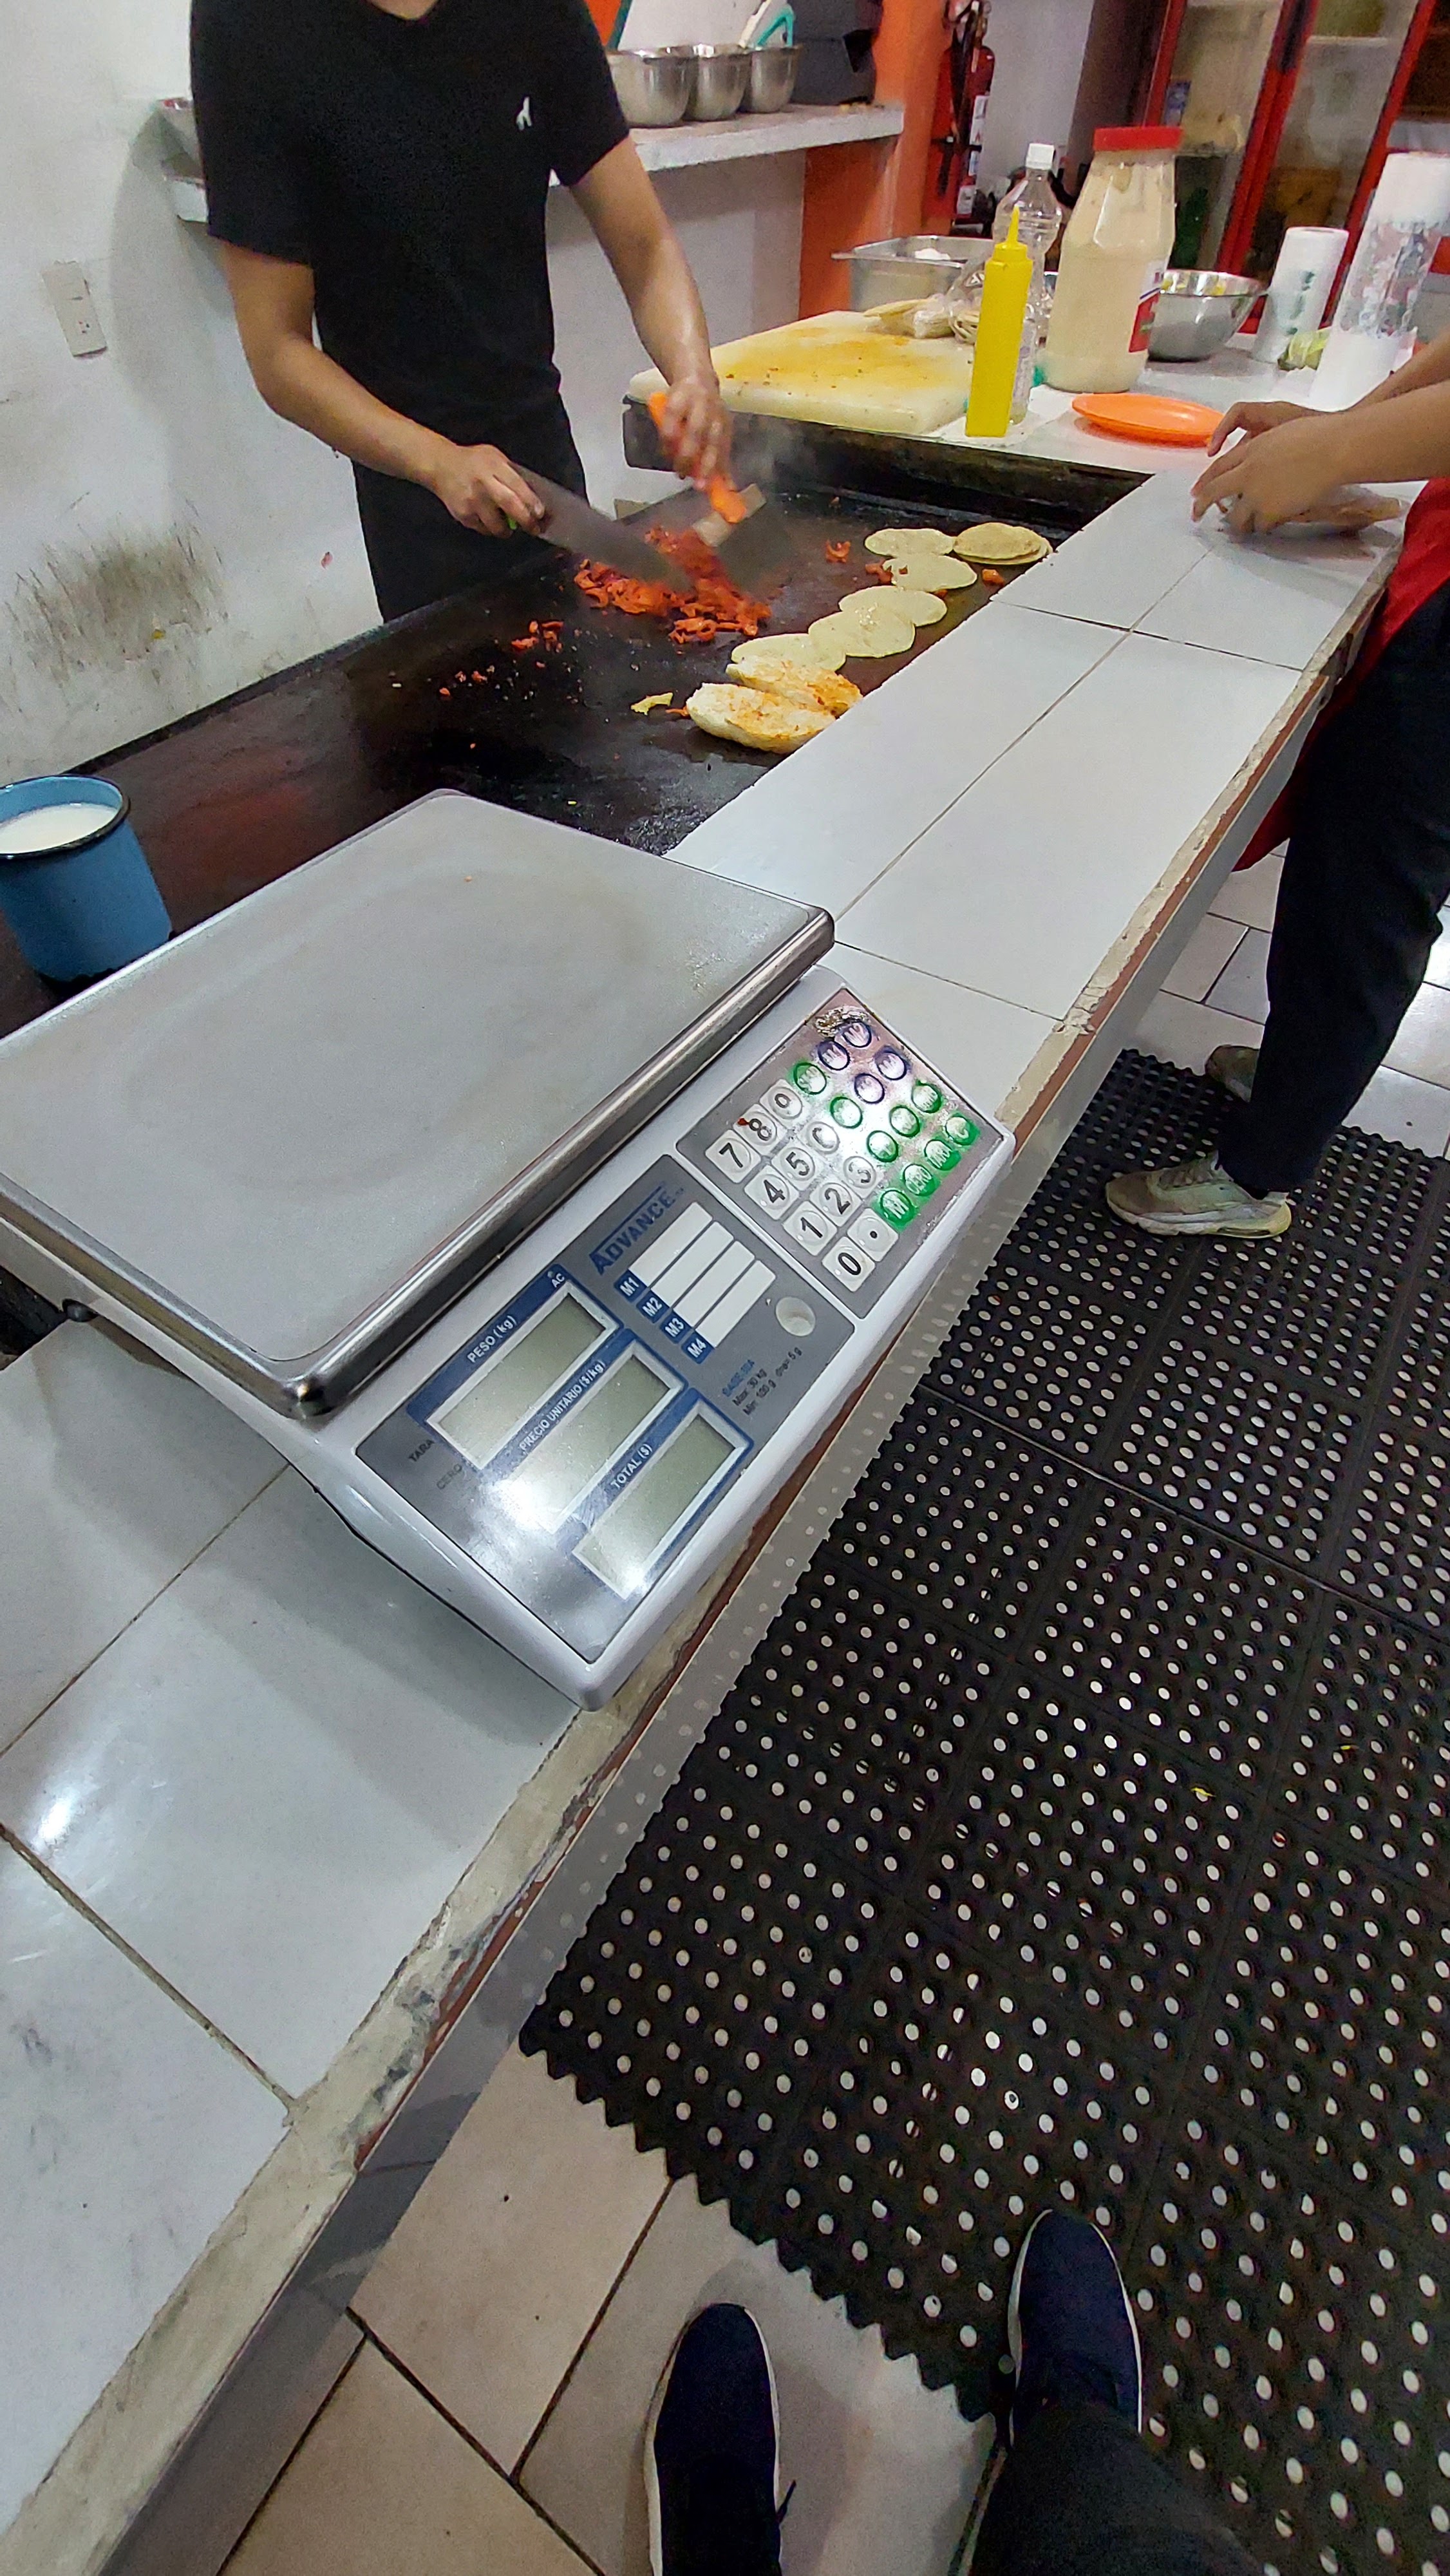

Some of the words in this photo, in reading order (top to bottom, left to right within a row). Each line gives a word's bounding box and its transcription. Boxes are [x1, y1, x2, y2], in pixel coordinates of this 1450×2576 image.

[748, 1117, 771, 1142] 8
[719, 1142, 743, 1169] 7
[785, 1151, 810, 1177] 5
[848, 1162, 872, 1184] 3
[764, 1179, 786, 1204] 4
[825, 1187, 851, 1215] 2
[589, 1189, 676, 1276] ADVANCE
[802, 1217, 824, 1239] 1
[838, 1252, 862, 1276] 0
[551, 1273, 565, 1288] AC
[619, 1277, 640, 1297] M1
[642, 1296, 663, 1317] M2
[467, 1336, 495, 1363] PESO
[493, 1315, 517, 1338] (kg)
[664, 1317, 684, 1337] M3
[687, 1338, 706, 1358] M4
[519, 1421, 550, 1452] PRECIO
[547, 1384, 582, 1421] UNITARIO
[579, 1360, 607, 1388] ($/kg)
[408, 1438, 435, 1463] TARA
[436, 1463, 463, 1490] CERO
[610, 1458, 643, 1490] TOTAL
[637, 1443, 653, 1459] ($)
